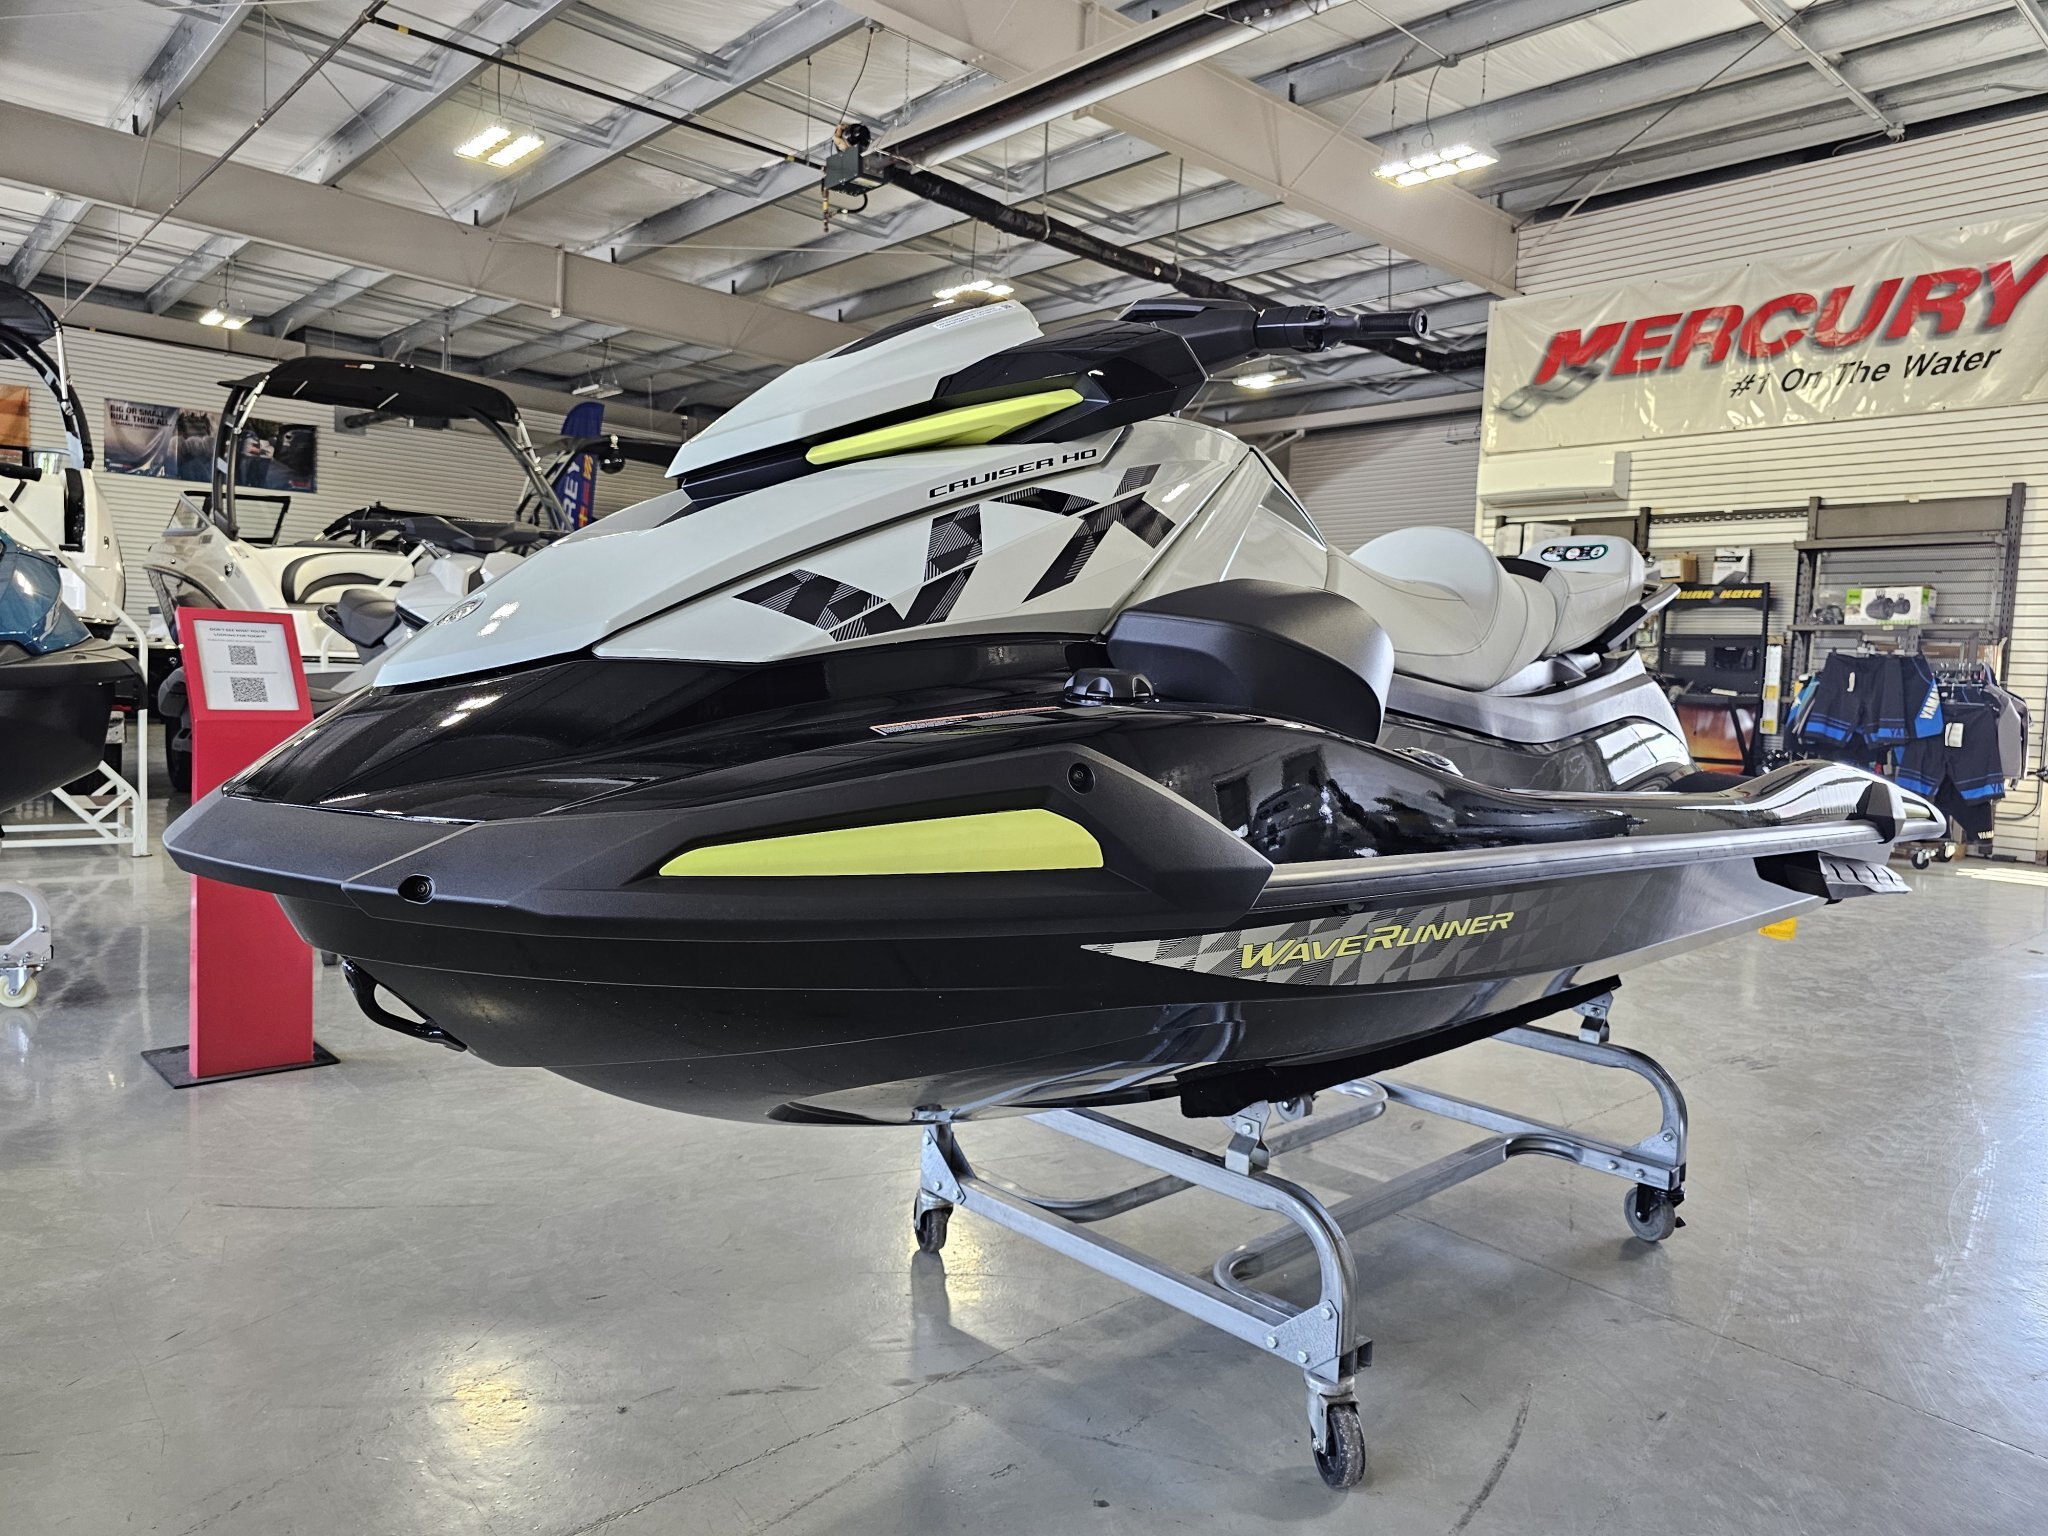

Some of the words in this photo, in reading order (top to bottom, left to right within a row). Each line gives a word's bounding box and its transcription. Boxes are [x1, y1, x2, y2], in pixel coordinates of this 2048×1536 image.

[1534, 254, 2048, 385] MERCURY
[1731, 371, 1769, 398] #1
[1782, 367, 1822, 393] On
[1835, 358, 1891, 386] The
[1903, 346, 2002, 379] Water
[110, 404, 124, 413] BIG
[126, 406, 137, 414] OR
[110, 412, 129, 421] RULE
[133, 415, 155, 425] THEM
[929, 457, 1054, 498] CRUISER
[1062, 448, 1097, 464] HO
